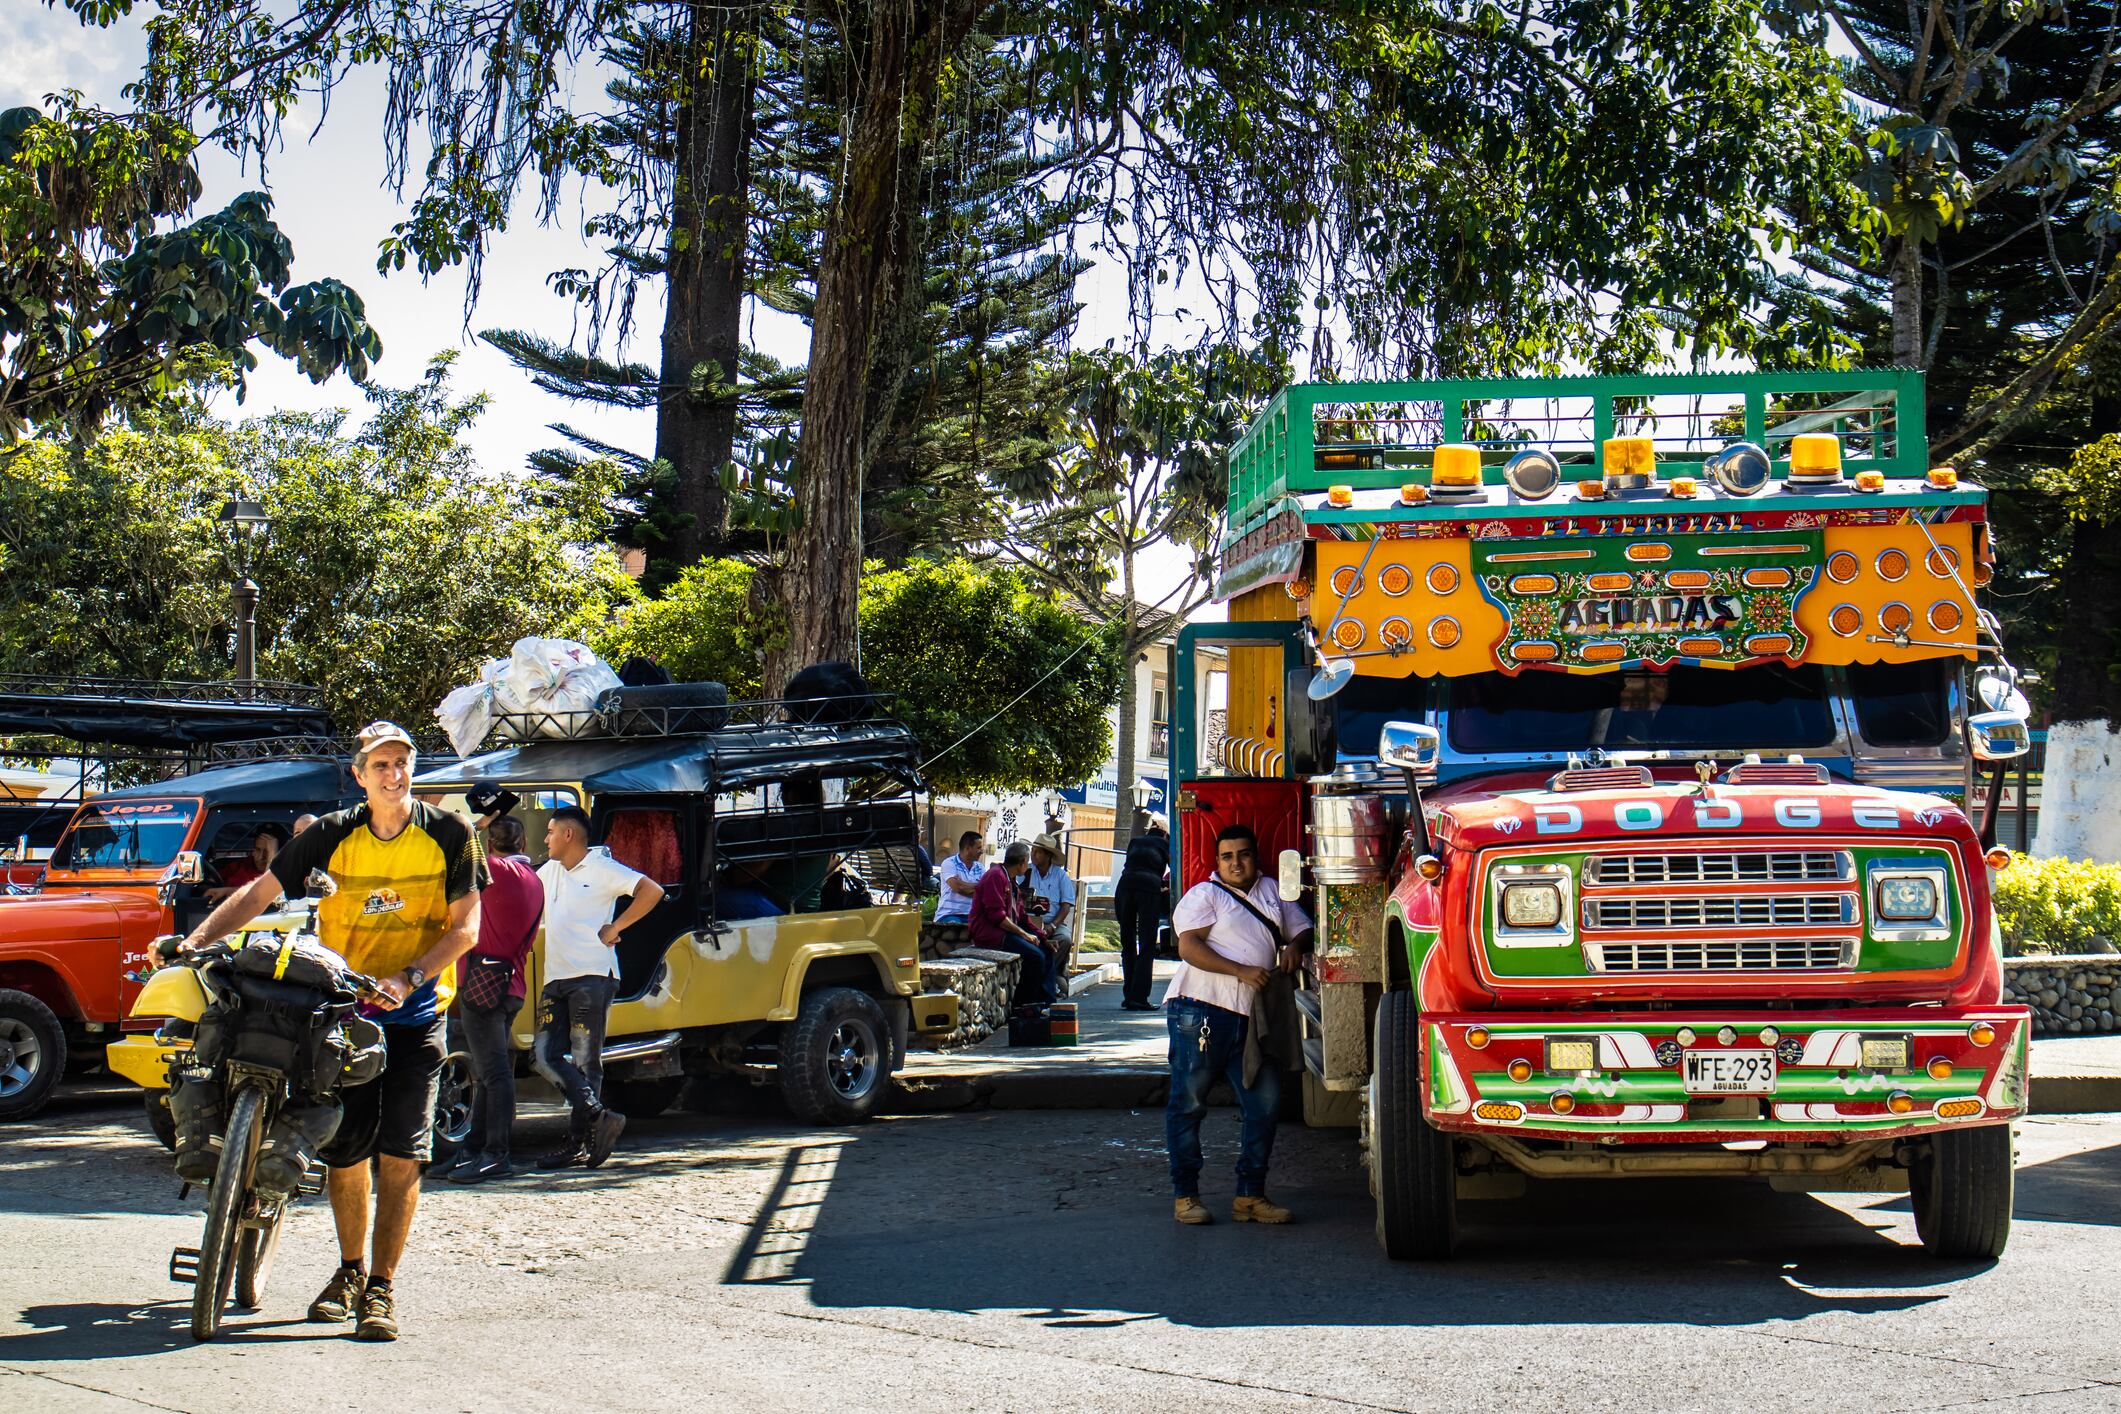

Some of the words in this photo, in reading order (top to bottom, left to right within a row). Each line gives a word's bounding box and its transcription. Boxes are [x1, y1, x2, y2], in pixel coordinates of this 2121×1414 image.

[1542, 517, 1589, 536] EL
[1559, 595, 1742, 632] AGUADAS
[99, 804, 174, 815] Jeep
[1533, 798, 1900, 835] DODGE
[123, 952, 149, 964] Jee
[1712, 1082, 1748, 1090] AGUADAS
